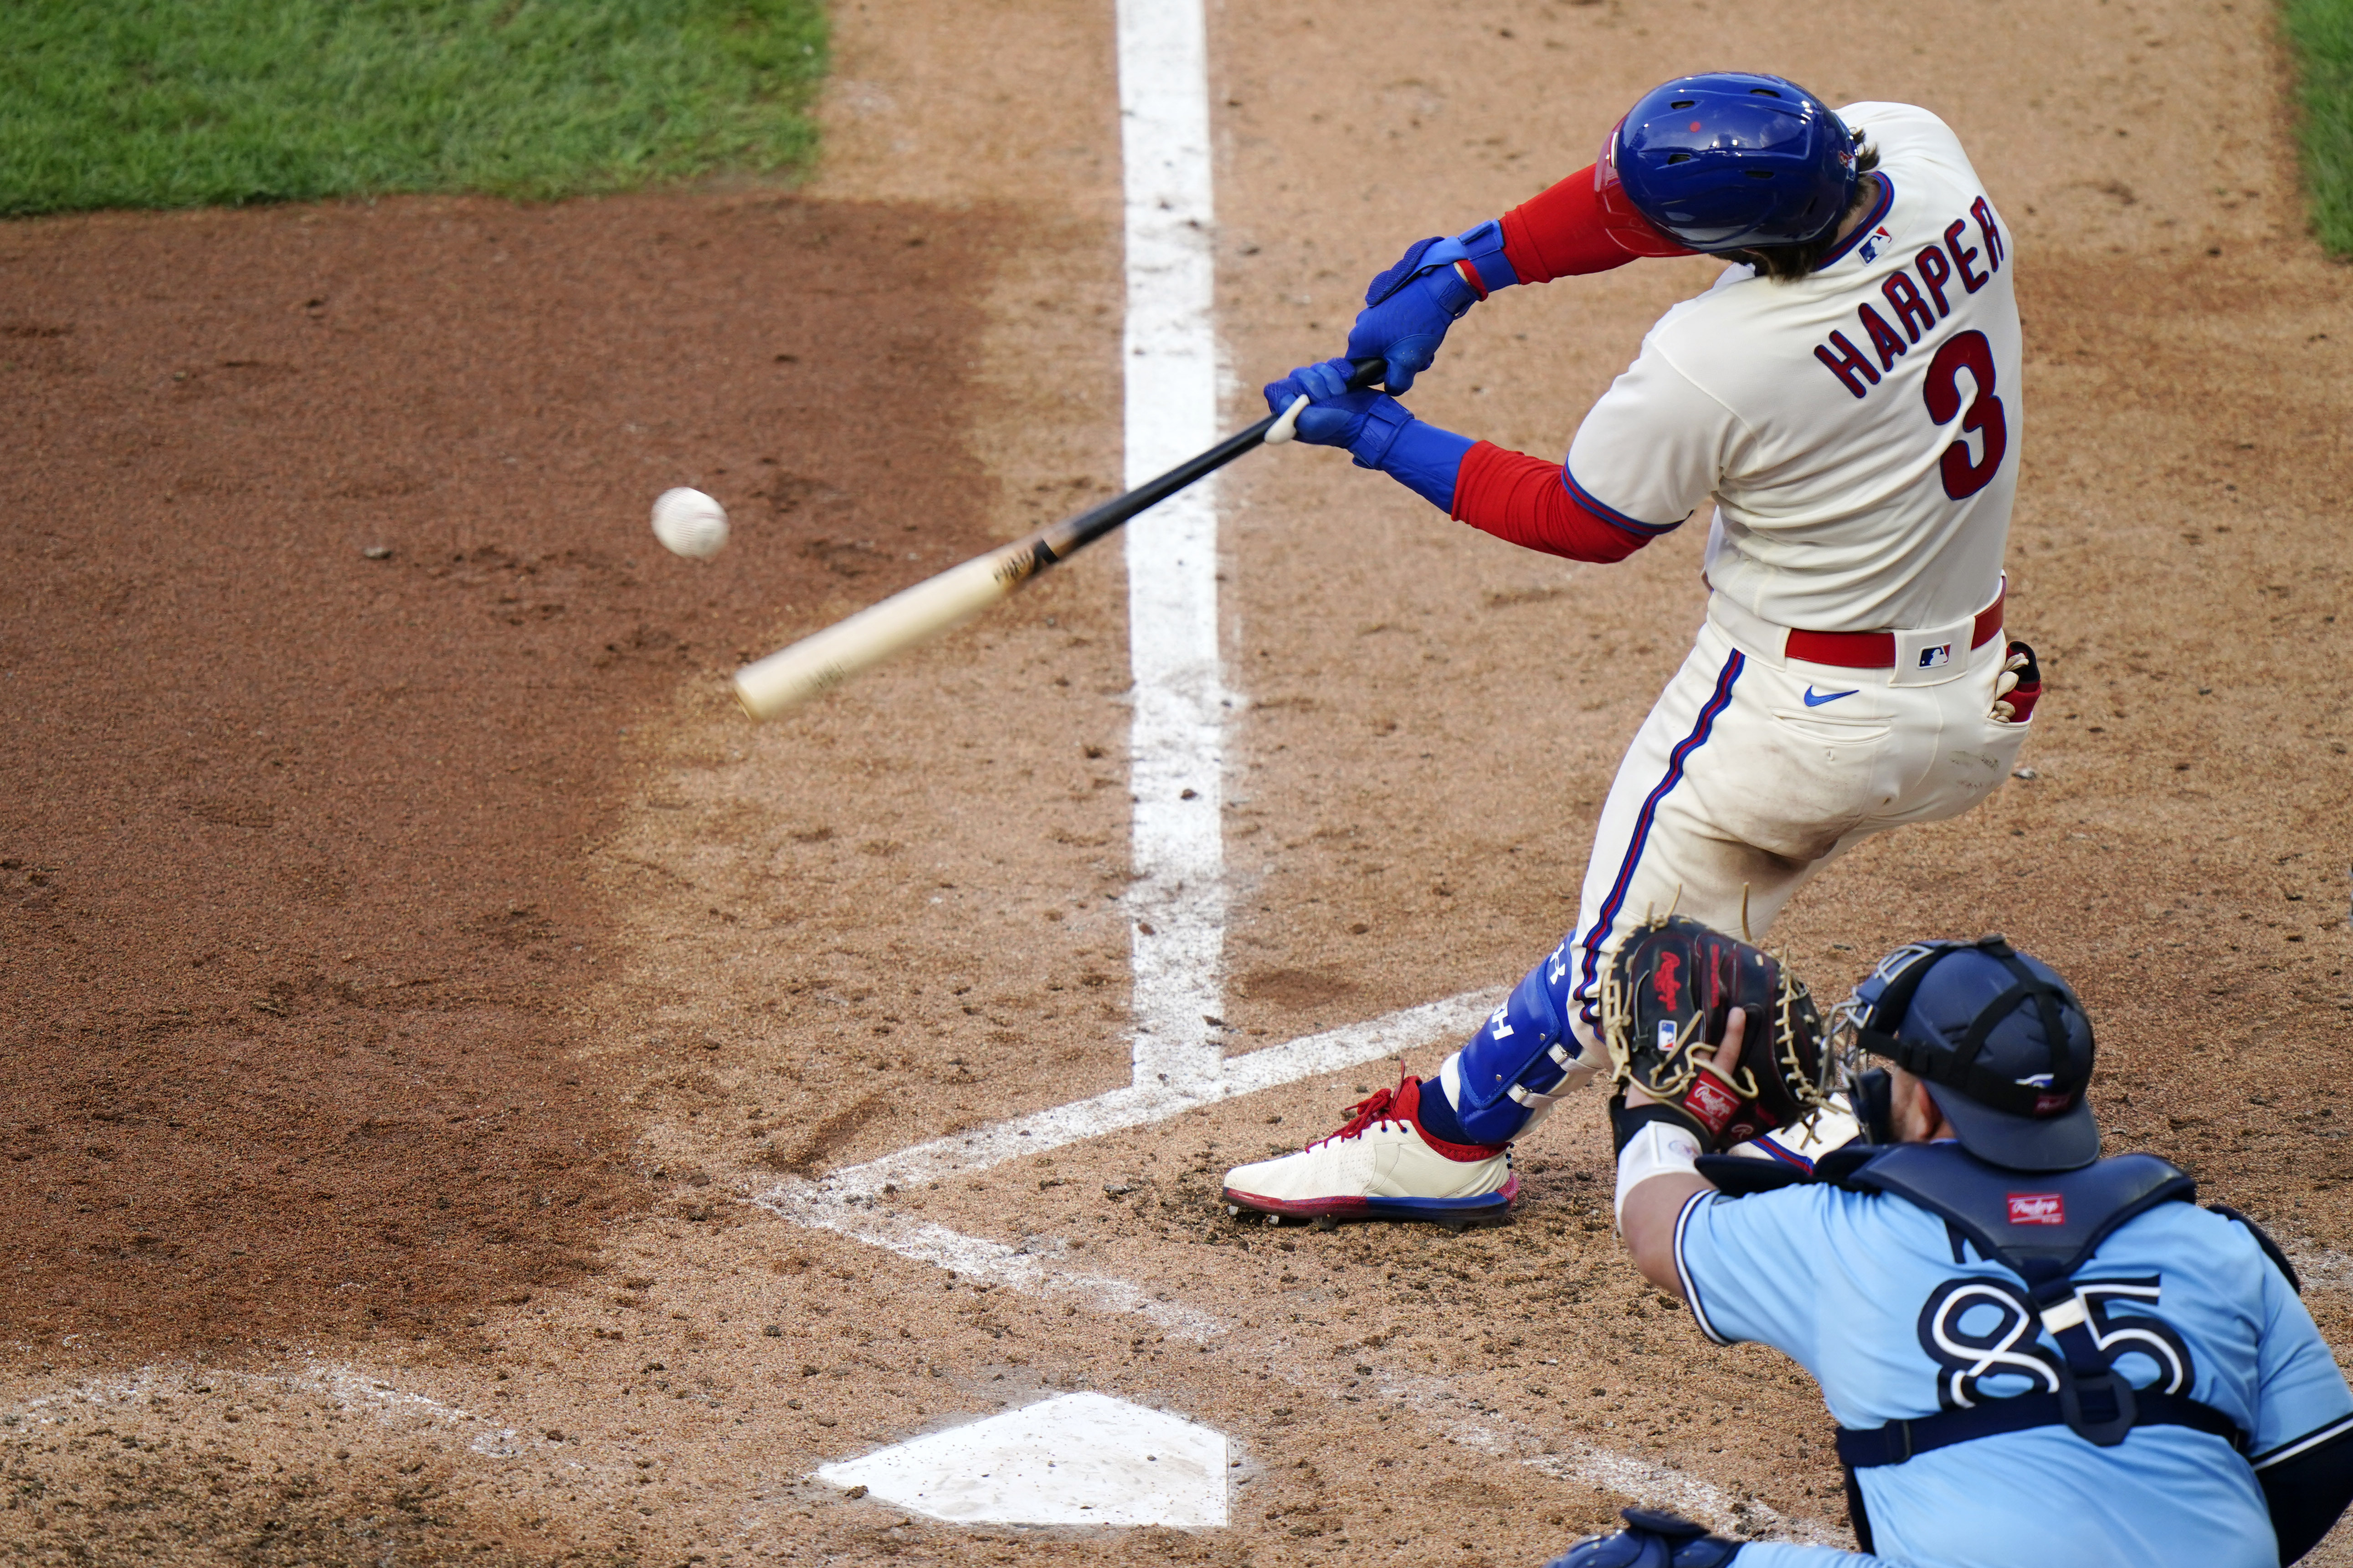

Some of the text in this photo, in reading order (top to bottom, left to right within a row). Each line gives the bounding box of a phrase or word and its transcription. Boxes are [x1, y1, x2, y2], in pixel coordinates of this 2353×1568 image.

[1814, 195, 2004, 398] HARPER
[1923, 329, 2007, 501] 3
[1917, 1274, 2194, 1410] 85
